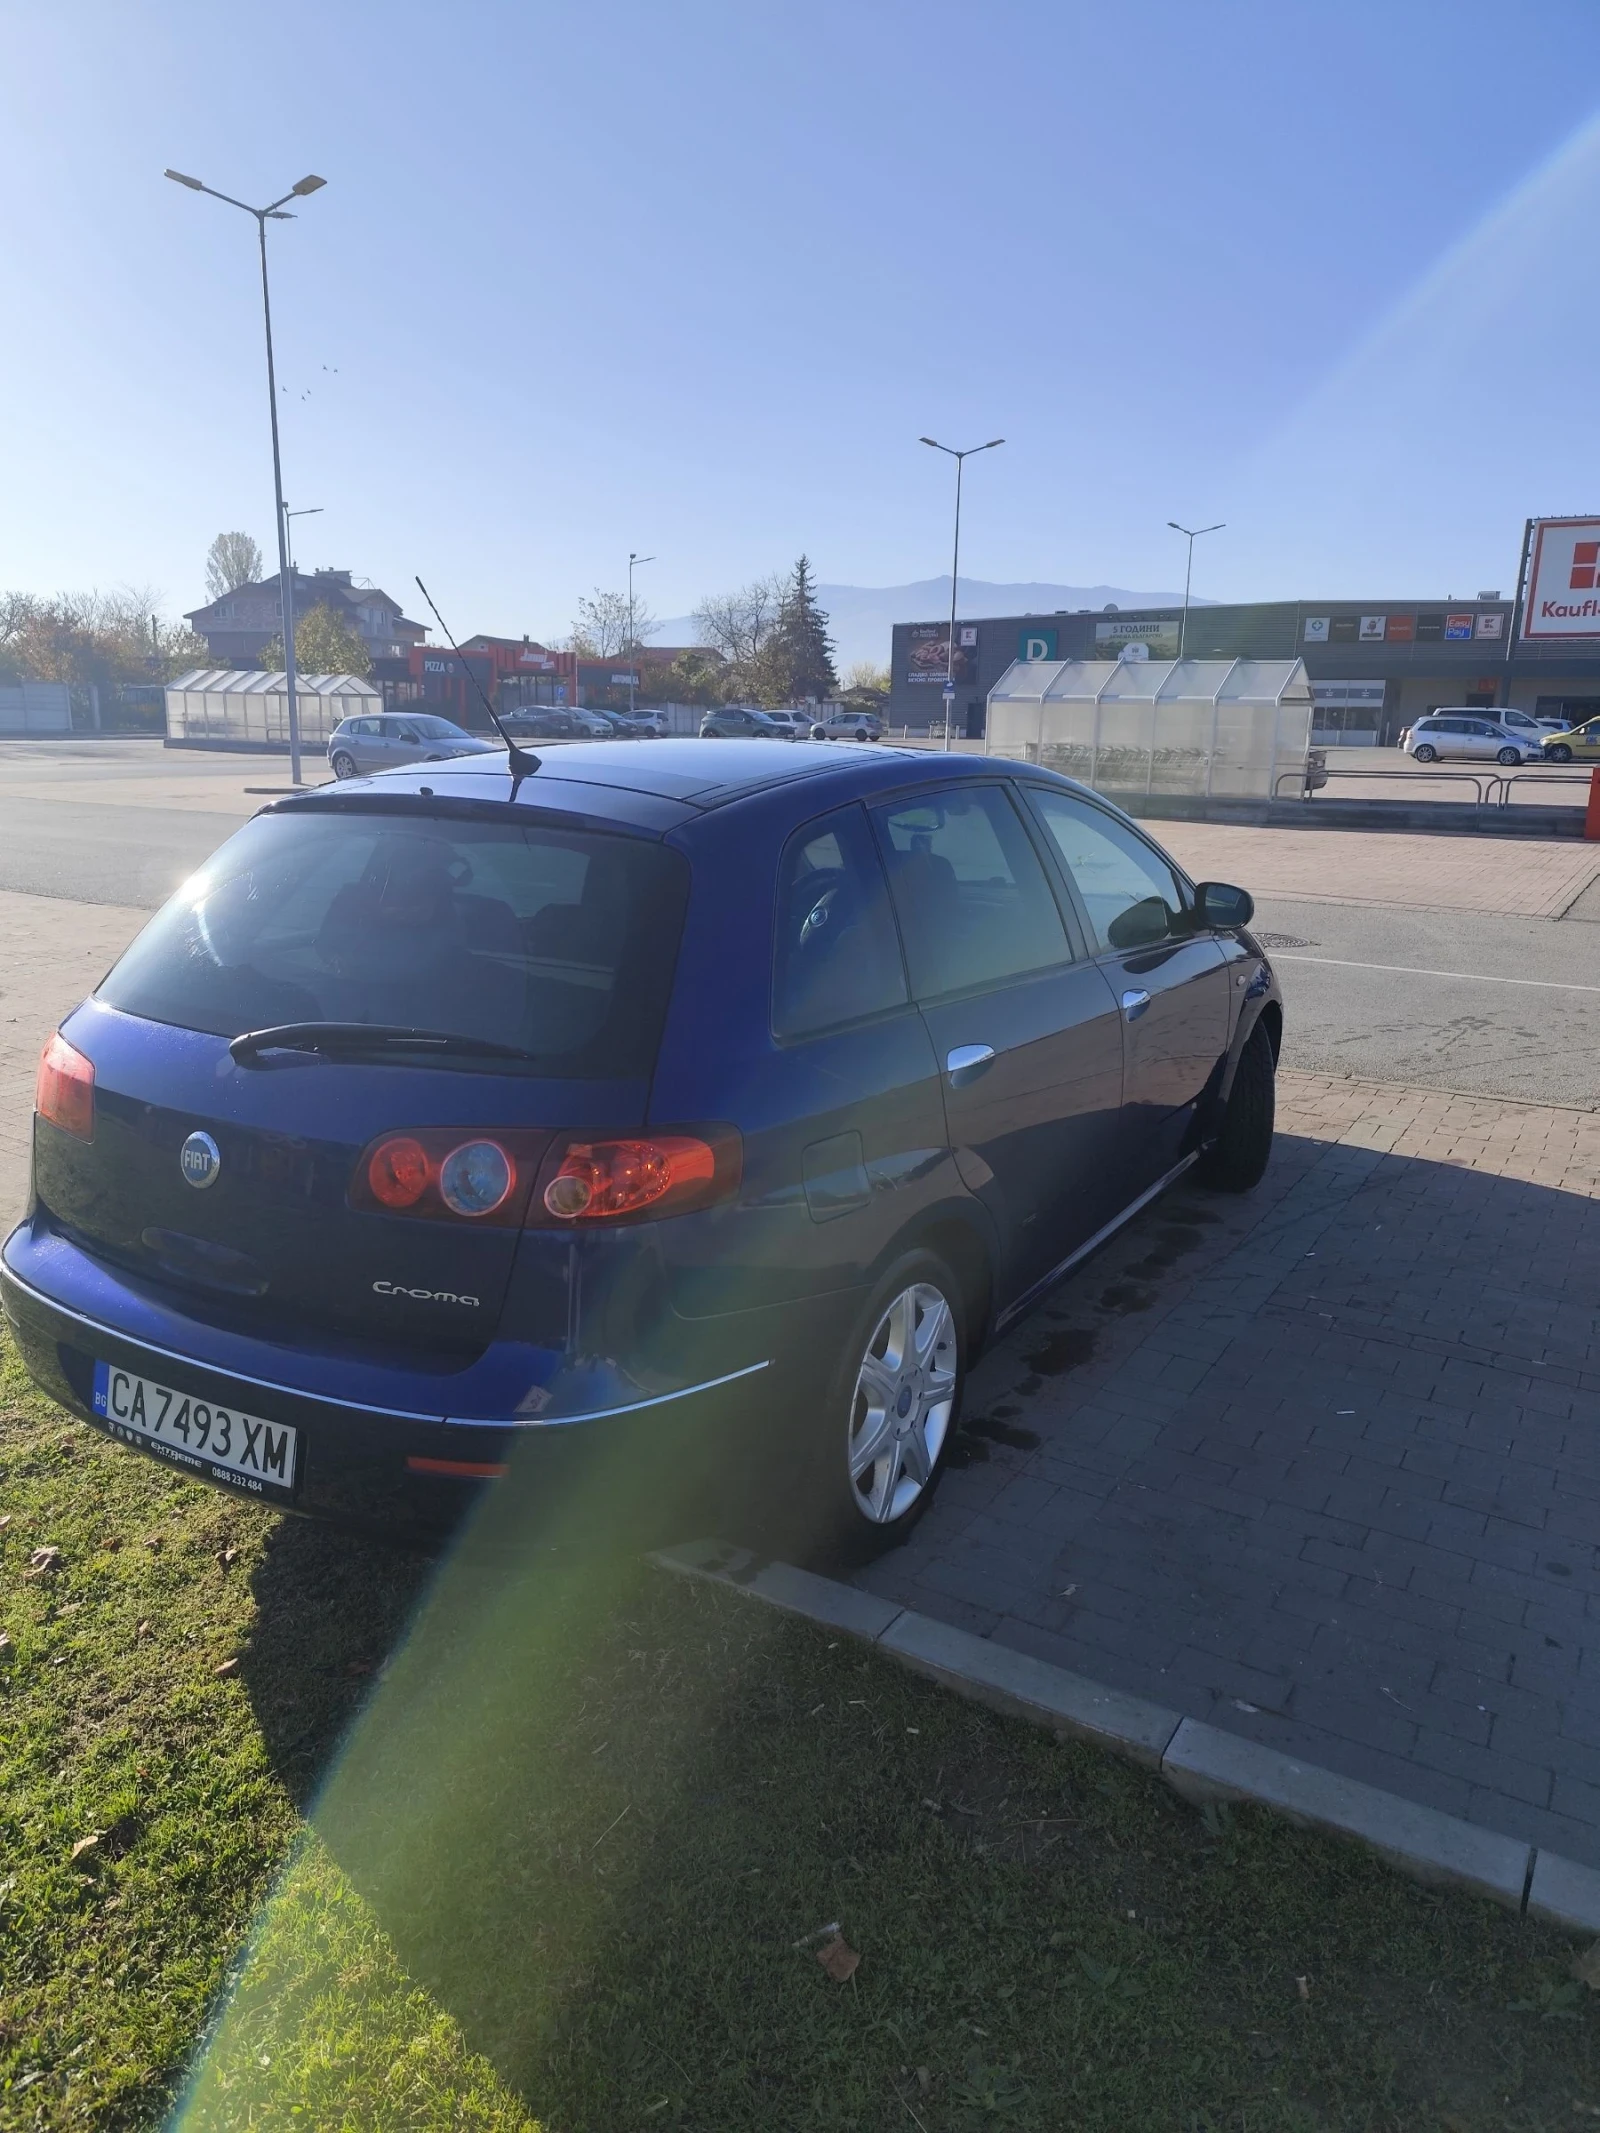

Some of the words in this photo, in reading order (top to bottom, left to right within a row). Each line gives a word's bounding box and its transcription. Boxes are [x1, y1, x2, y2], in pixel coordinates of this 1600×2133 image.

[1541, 600, 1600, 617] Kaufl
[1120, 625, 1160, 633] ГОДИНИ
[1447, 628, 1465, 636] Pay
[1449, 620, 1470, 628] Easy
[1026, 638, 1048, 661] D
[424, 661, 445, 672] PIZZA
[184, 1149, 211, 1171] FIAT
[372, 1281, 480, 1306] Croma
[95, 1391, 107, 1408] BG
[212, 1466, 231, 1482] 0888
[232, 1474, 246, 1487] 232
[247, 1480, 263, 1492] 484
